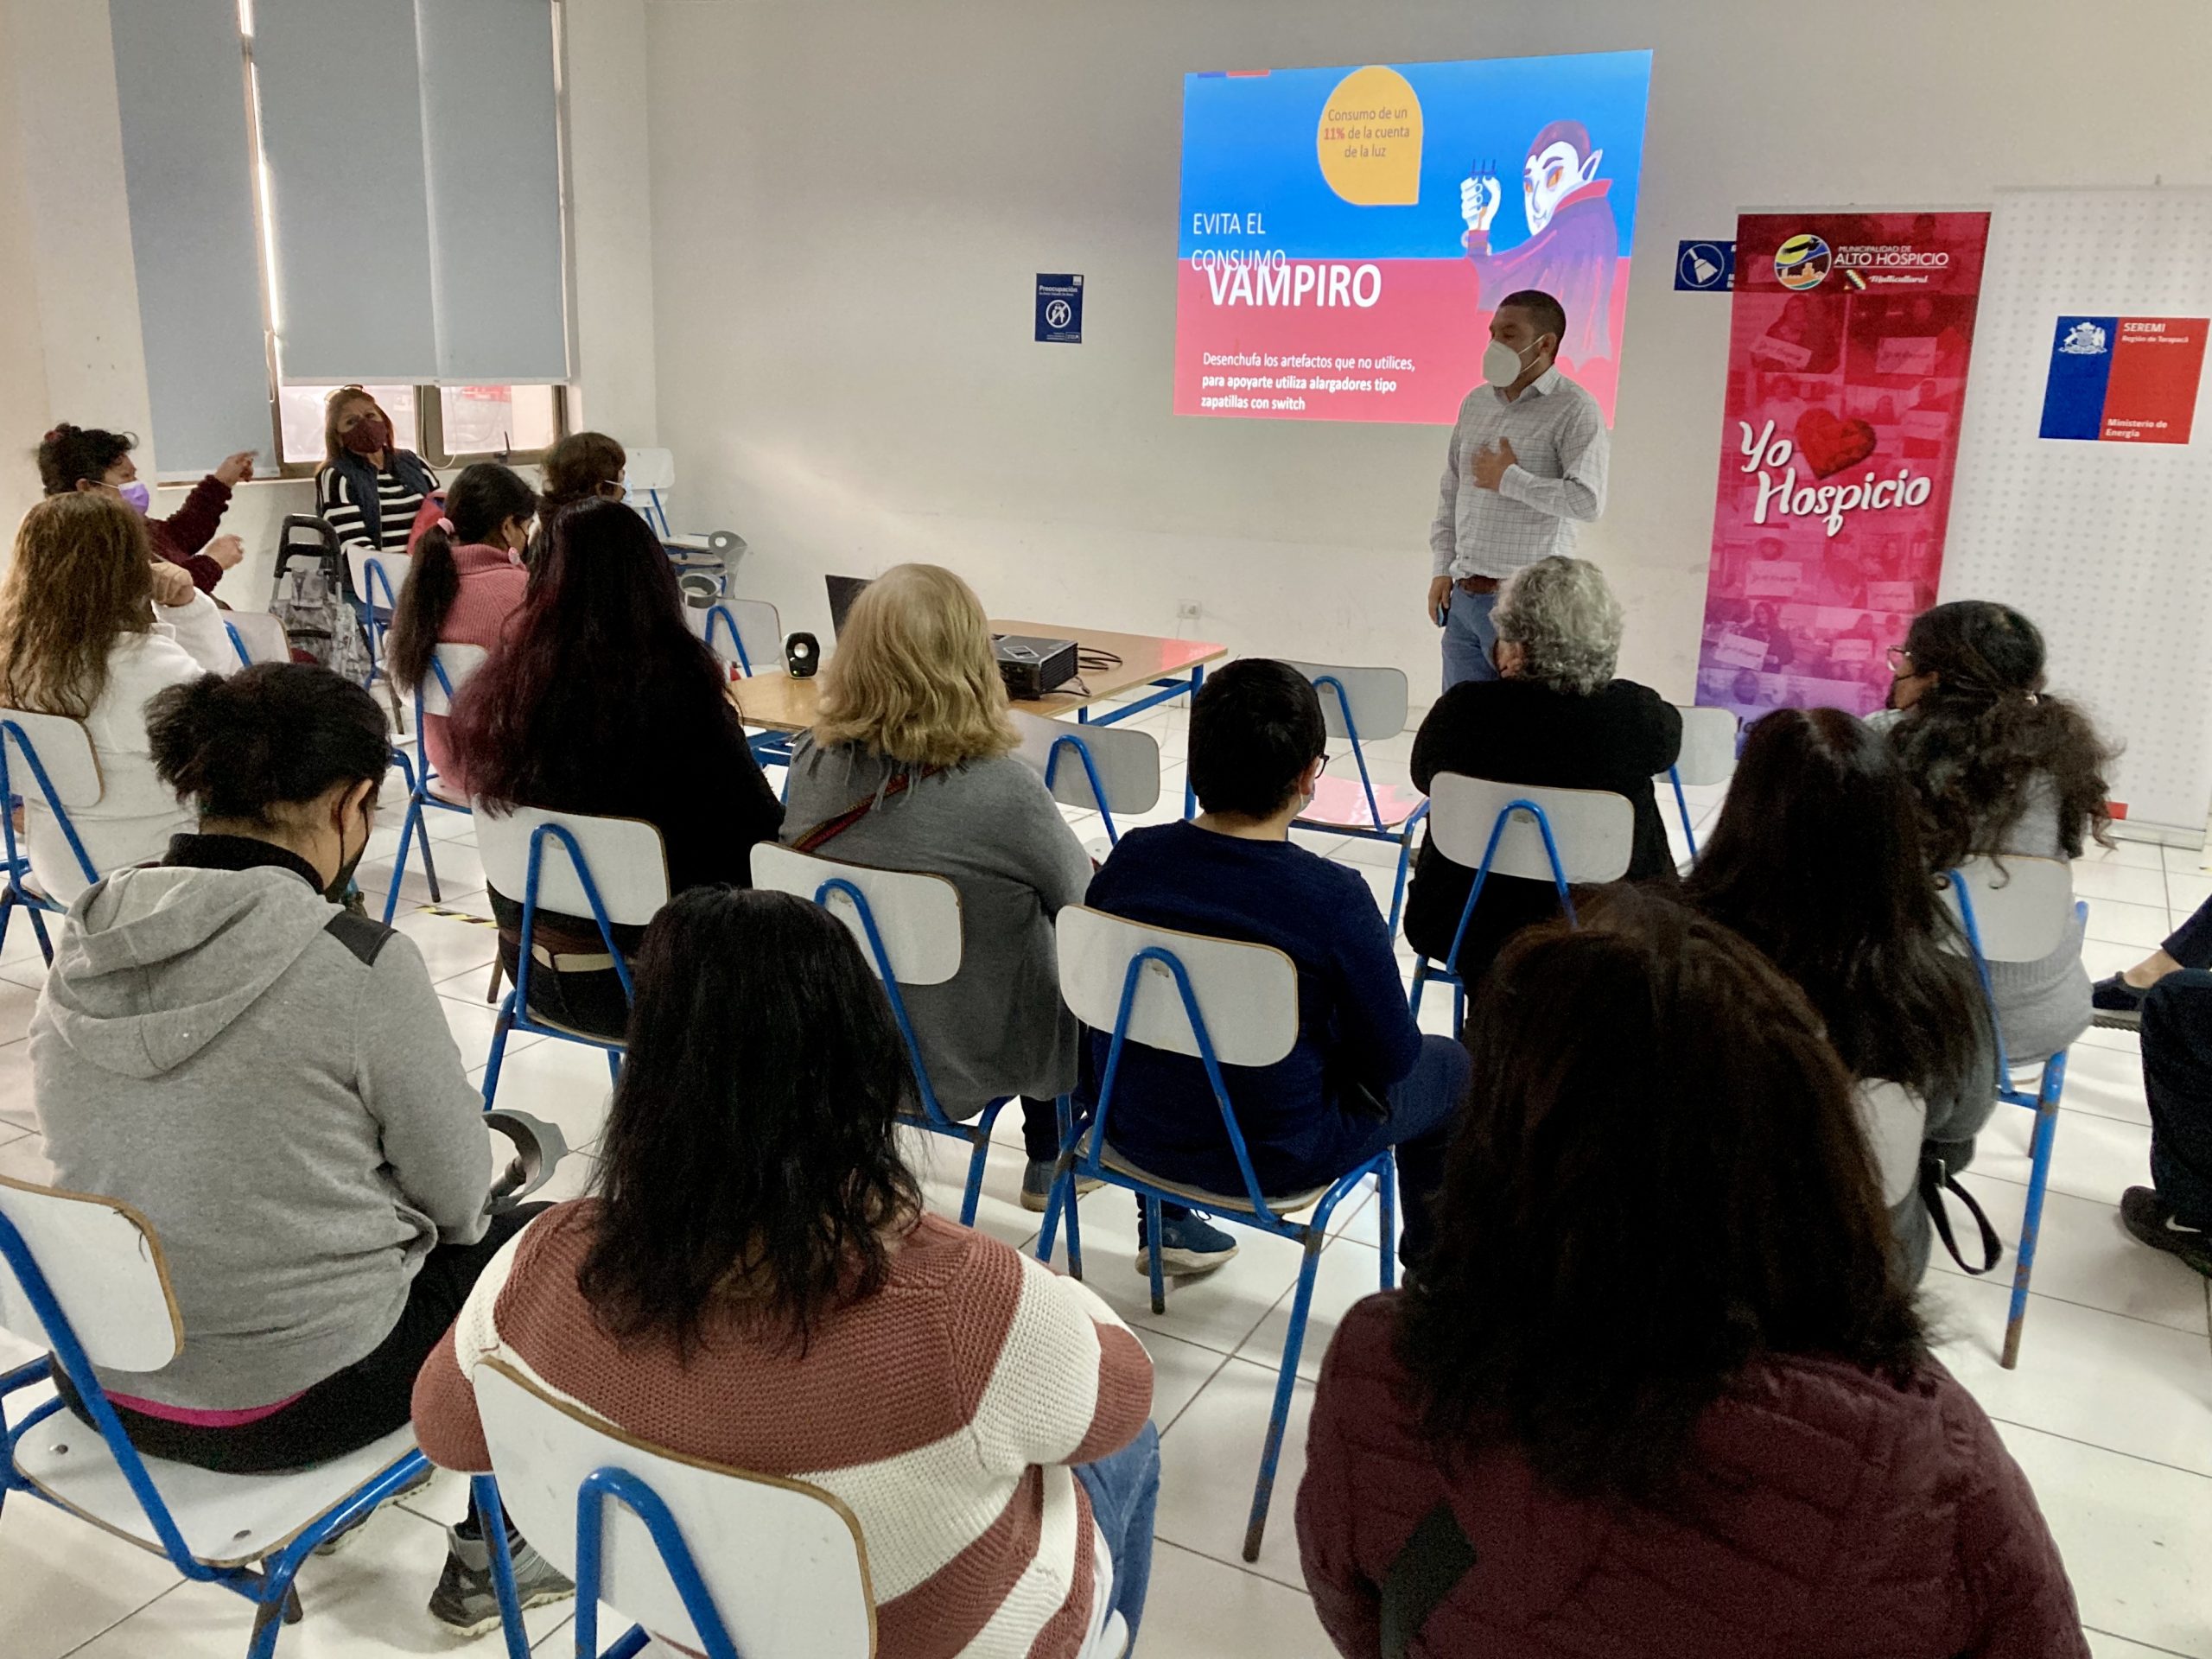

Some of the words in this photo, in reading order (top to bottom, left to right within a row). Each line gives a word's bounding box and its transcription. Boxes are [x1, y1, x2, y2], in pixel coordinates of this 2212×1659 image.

[1328, 109, 1376, 122] Consumo
[1379, 107, 1392, 119] de
[1395, 109, 1408, 119] un
[1324, 127, 1345, 140] 11%
[1348, 126, 1360, 139] de
[1363, 125, 1372, 138] la
[1375, 127, 1410, 138] cuenta
[1344, 145, 1357, 157] de
[1360, 144, 1369, 157] la
[1371, 143, 1387, 157] luz
[1193, 213, 1241, 234] EVITA
[1246, 213, 1266, 234] EL
[1900, 245, 1912, 253] DE
[1192, 249, 1287, 271] CONSUMO
[1834, 252, 1872, 266] ALTO
[1876, 251, 1949, 266] HOSPICIO
[1208, 264, 1382, 308] VAMPIRO
[2123, 322, 2166, 333] SEREMI
[1203, 352, 1262, 367] Desenchufa
[1264, 353, 1279, 367] los
[1281, 353, 1332, 369] artefactos
[1334, 358, 1356, 372] que
[1357, 358, 1372, 369] no
[1374, 355, 1415, 372] utilices,
[1202, 376, 1225, 389] para
[1227, 375, 1274, 391] apoyarte
[1275, 375, 1307, 390] utiliza
[1308, 375, 1372, 393] alargadores
[1374, 377, 1397, 394] tipo
[1201, 394, 1249, 410] zapatillas
[1250, 397, 1269, 410] con
[1271, 396, 1306, 410] switch
[2107, 418, 2155, 428] Ministerio
[2156, 420, 2168, 429] de
[2105, 428, 2140, 439] Energía
[1738, 419, 1793, 474] Yo
[1753, 467, 1931, 537] Hospicio
